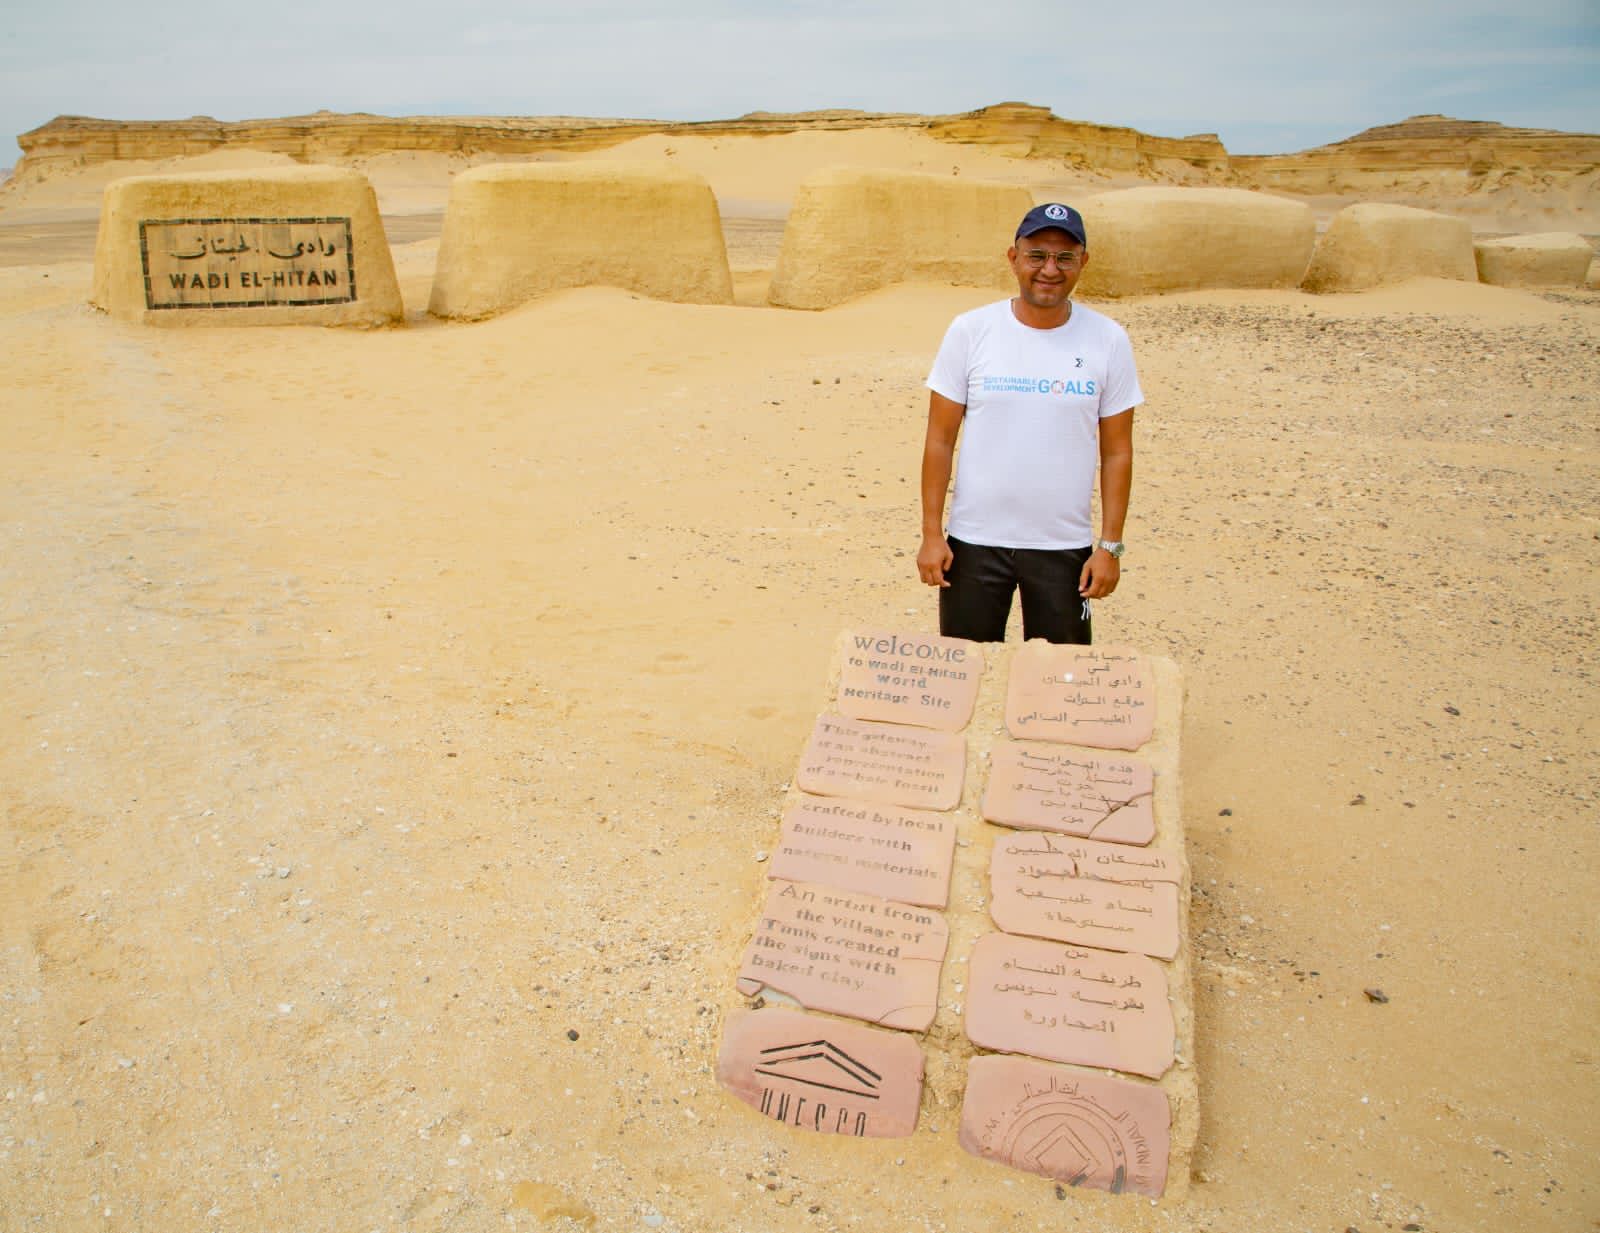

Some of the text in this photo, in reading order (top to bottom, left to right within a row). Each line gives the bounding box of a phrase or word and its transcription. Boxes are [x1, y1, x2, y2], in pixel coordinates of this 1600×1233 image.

[169, 269, 337, 289] WADI EL-HITAN
[1038, 379, 1096, 396] GOALS
[921, 694, 951, 709] Site
[872, 813, 893, 826] by
[897, 816, 944, 833] local
[1096, 854, 1167, 870] السكان
[780, 884, 815, 903] An
[884, 903, 933, 926] from
[796, 908, 925, 944] the village of
[755, 935, 897, 976] the signs with
[824, 934, 901, 959] created
[1064, 949, 1089, 960] من
[751, 953, 815, 978] baked
